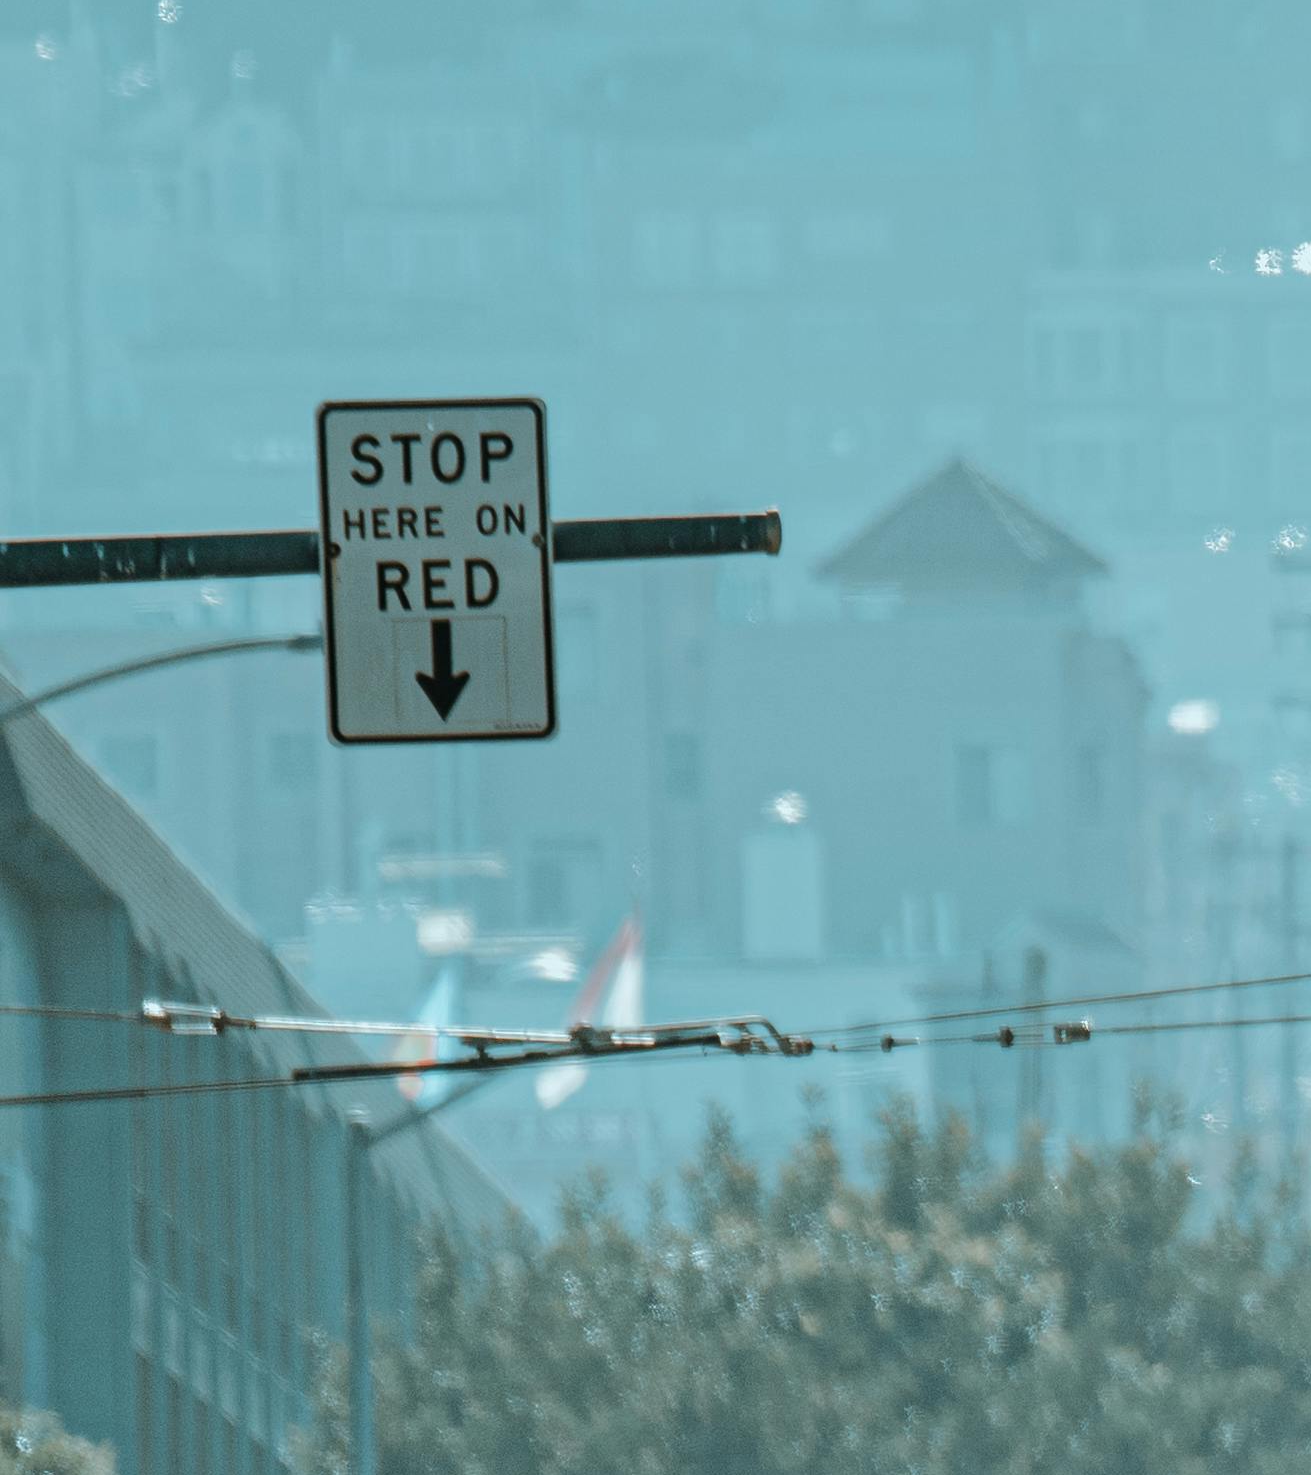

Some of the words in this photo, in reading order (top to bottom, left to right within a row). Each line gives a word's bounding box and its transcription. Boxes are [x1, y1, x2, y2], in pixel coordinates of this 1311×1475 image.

[351, 432, 514, 485] STOP
[343, 505, 445, 541] HERE
[476, 503, 527, 537] ON
[376, 557, 500, 612] RED
